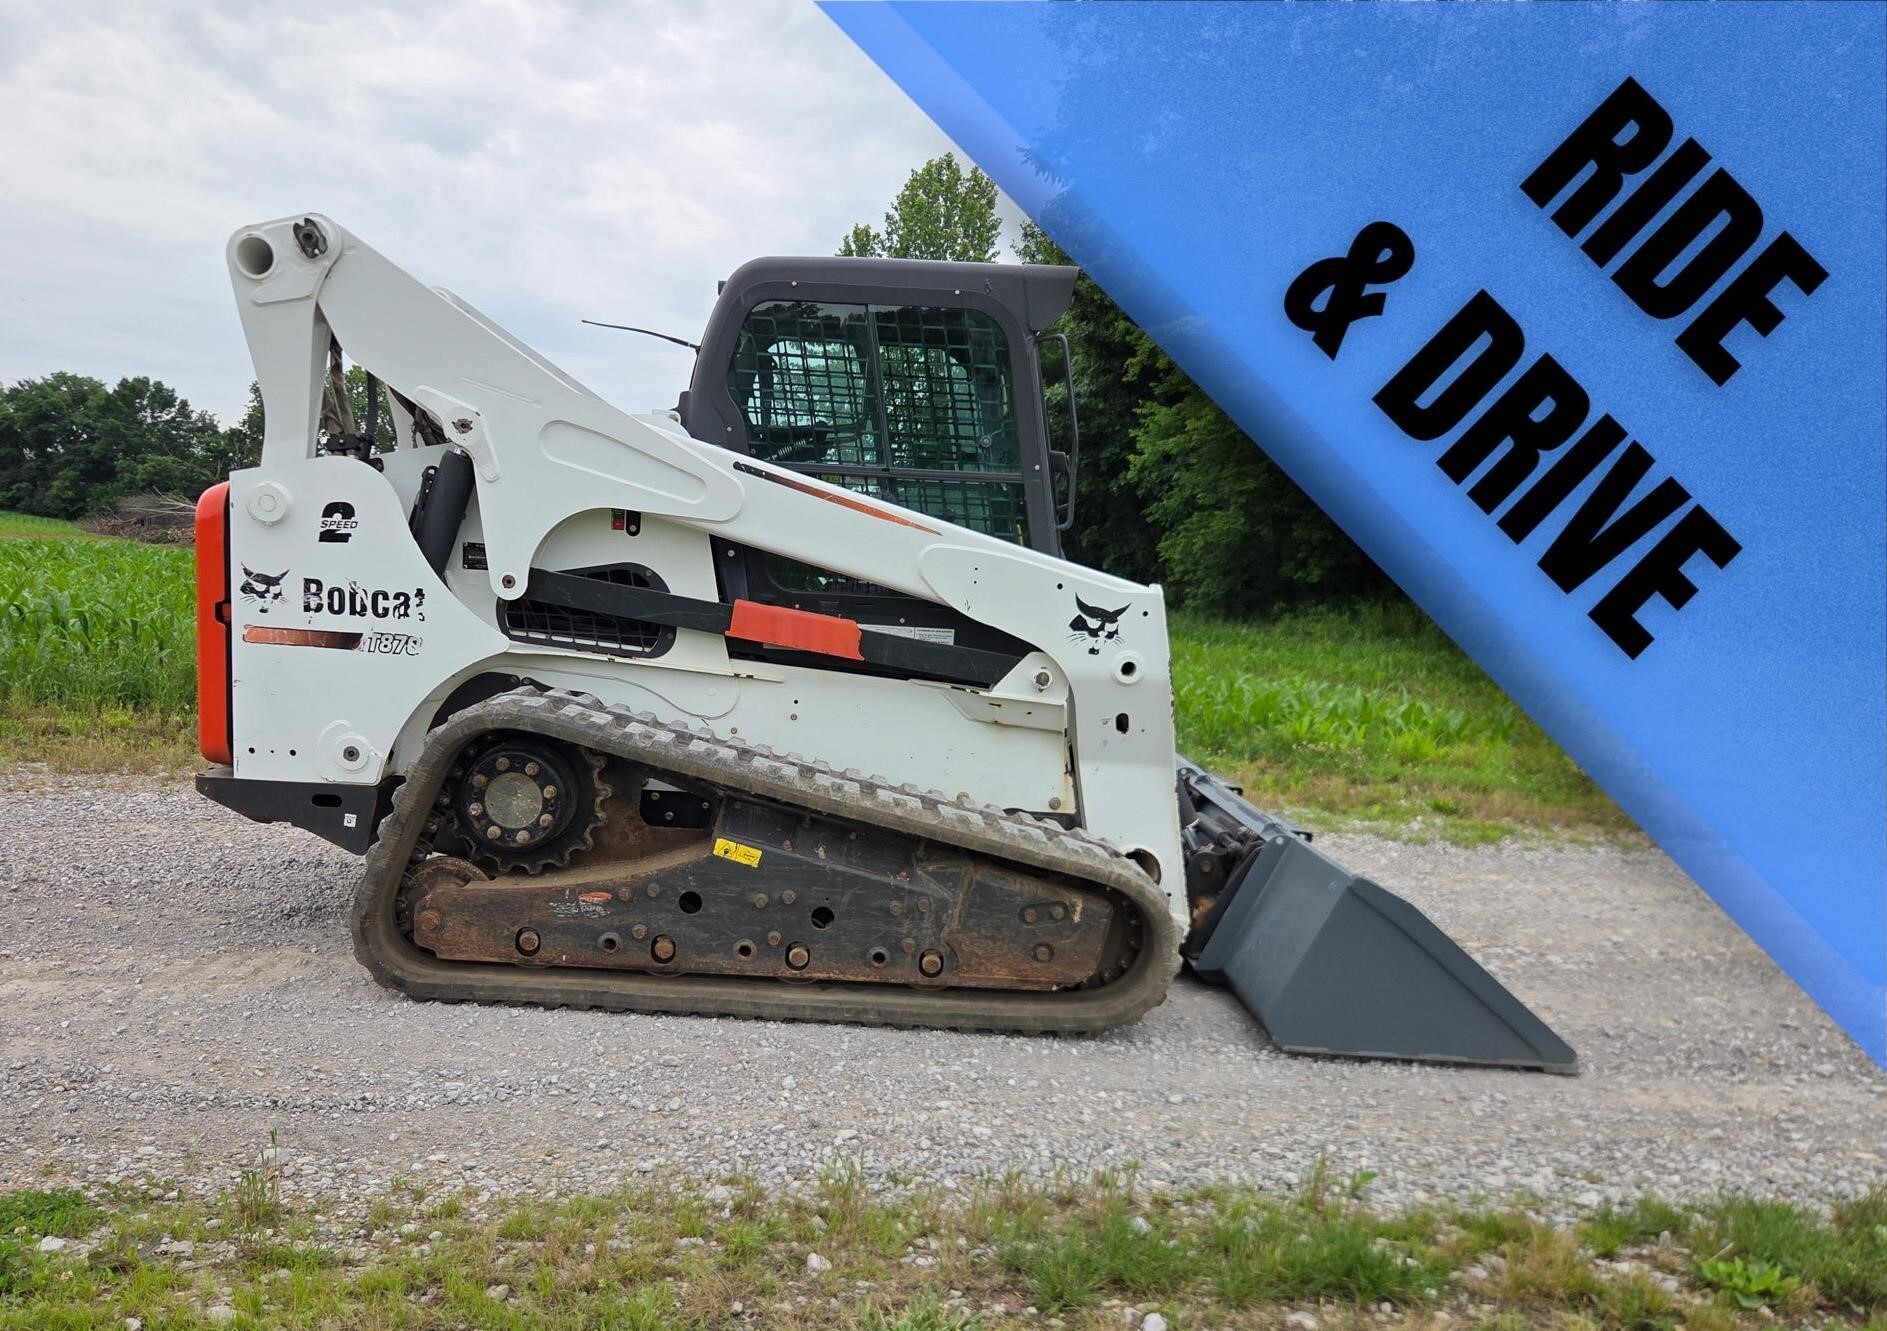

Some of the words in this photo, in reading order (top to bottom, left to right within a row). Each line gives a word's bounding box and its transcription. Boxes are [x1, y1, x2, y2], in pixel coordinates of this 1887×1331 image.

[318, 501, 356, 543] 2
[320, 520, 358, 529] SPEED
[303, 577, 425, 622] Bobcat
